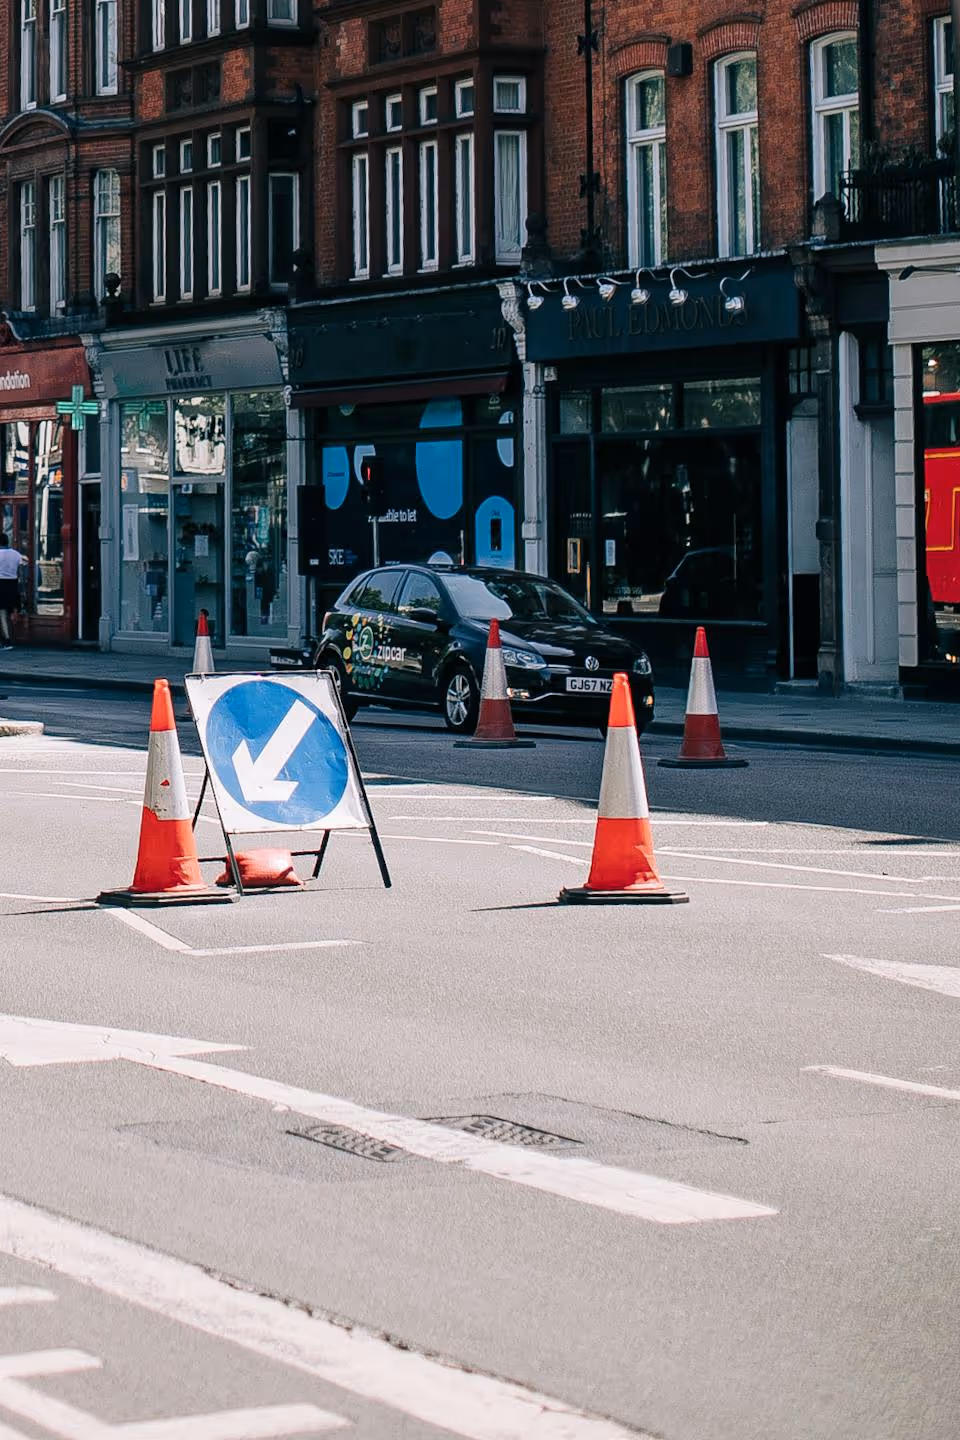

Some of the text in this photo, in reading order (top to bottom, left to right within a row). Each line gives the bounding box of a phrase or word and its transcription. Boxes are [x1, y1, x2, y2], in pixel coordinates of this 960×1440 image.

[568, 292, 749, 340] PAUL EDMONDS
[165, 375, 213, 392] PHARMACY
[399, 509, 407, 523] to
[407, 508, 417, 523] let
[377, 645, 407, 662] zipcar
[570, 678, 613, 692] GJ67 NZ
